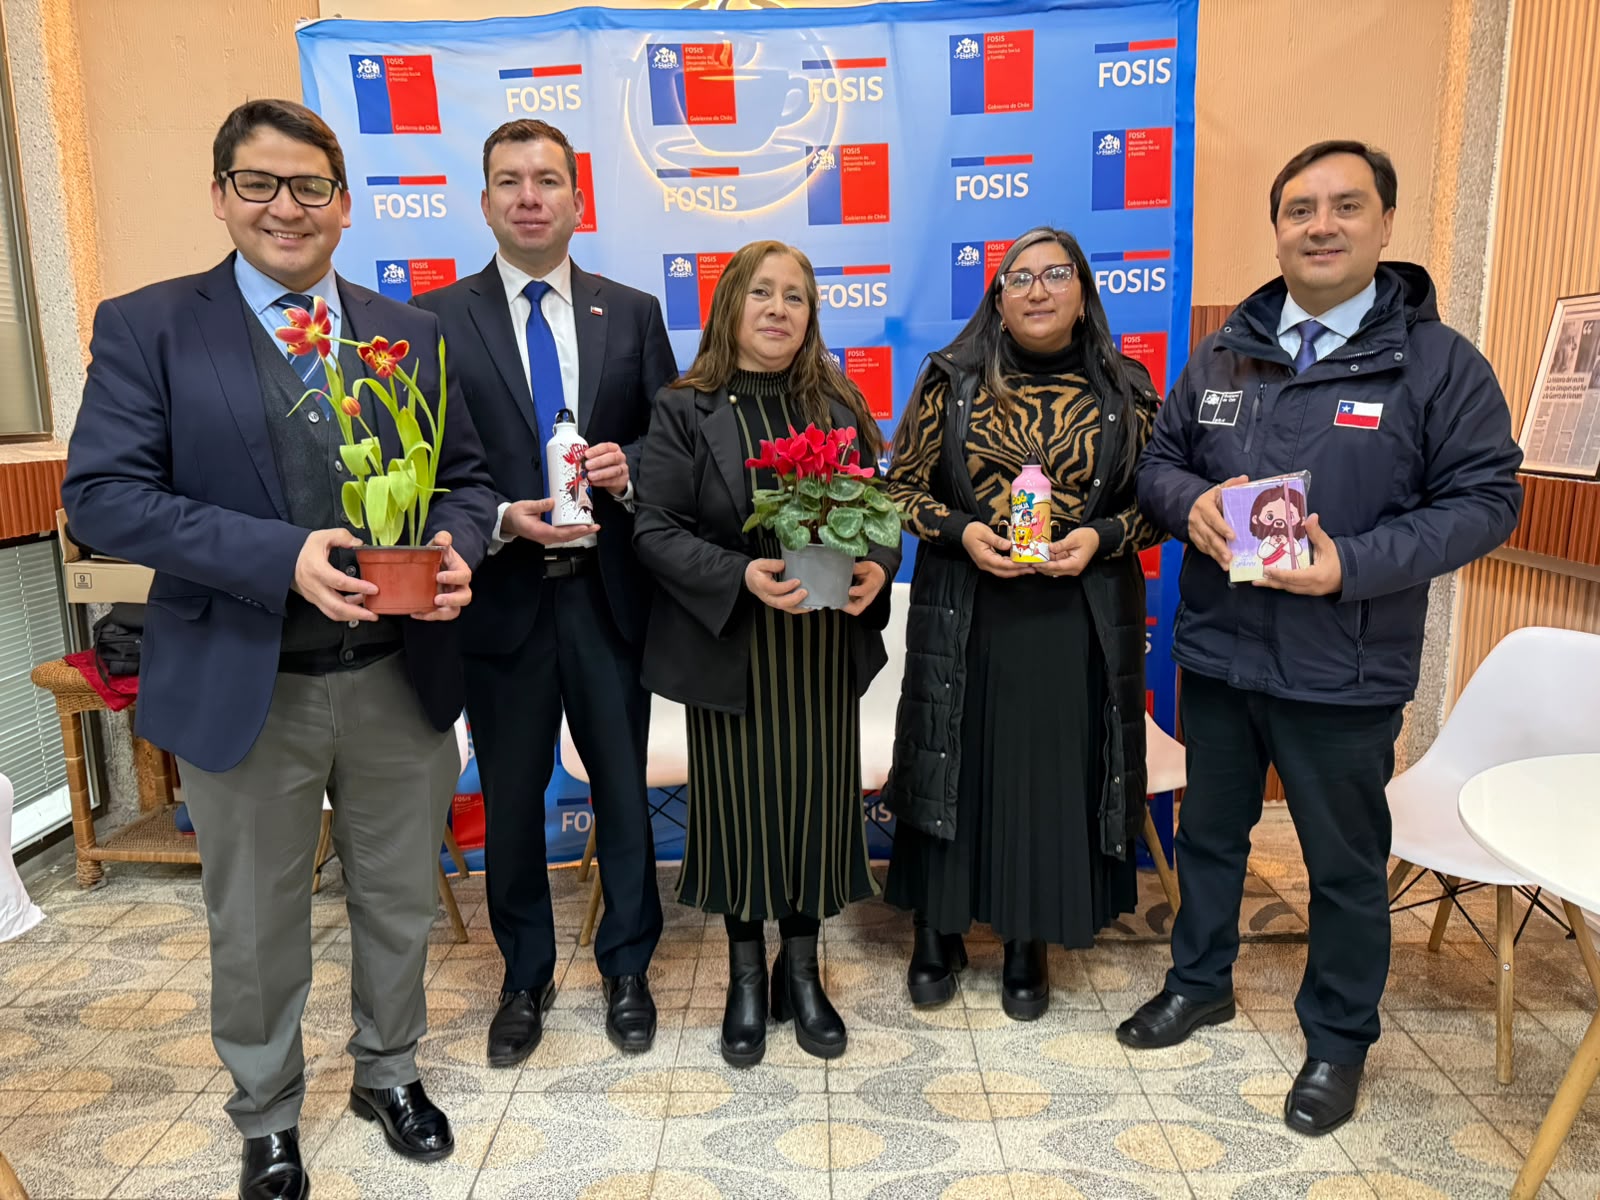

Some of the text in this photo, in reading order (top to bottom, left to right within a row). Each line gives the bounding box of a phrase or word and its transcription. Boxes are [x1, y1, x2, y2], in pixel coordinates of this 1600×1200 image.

[1098, 58, 1172, 88] FOSIS
[506, 84, 582, 113] FOSIS
[808, 76, 884, 103] FOSIS
[662, 185, 738, 212] FOSIS
[955, 172, 1029, 201] FOSIS
[374, 194, 448, 220] FOSIS
[818, 282, 888, 309] FOSIS
[1094, 267, 1166, 296] FOSIS
